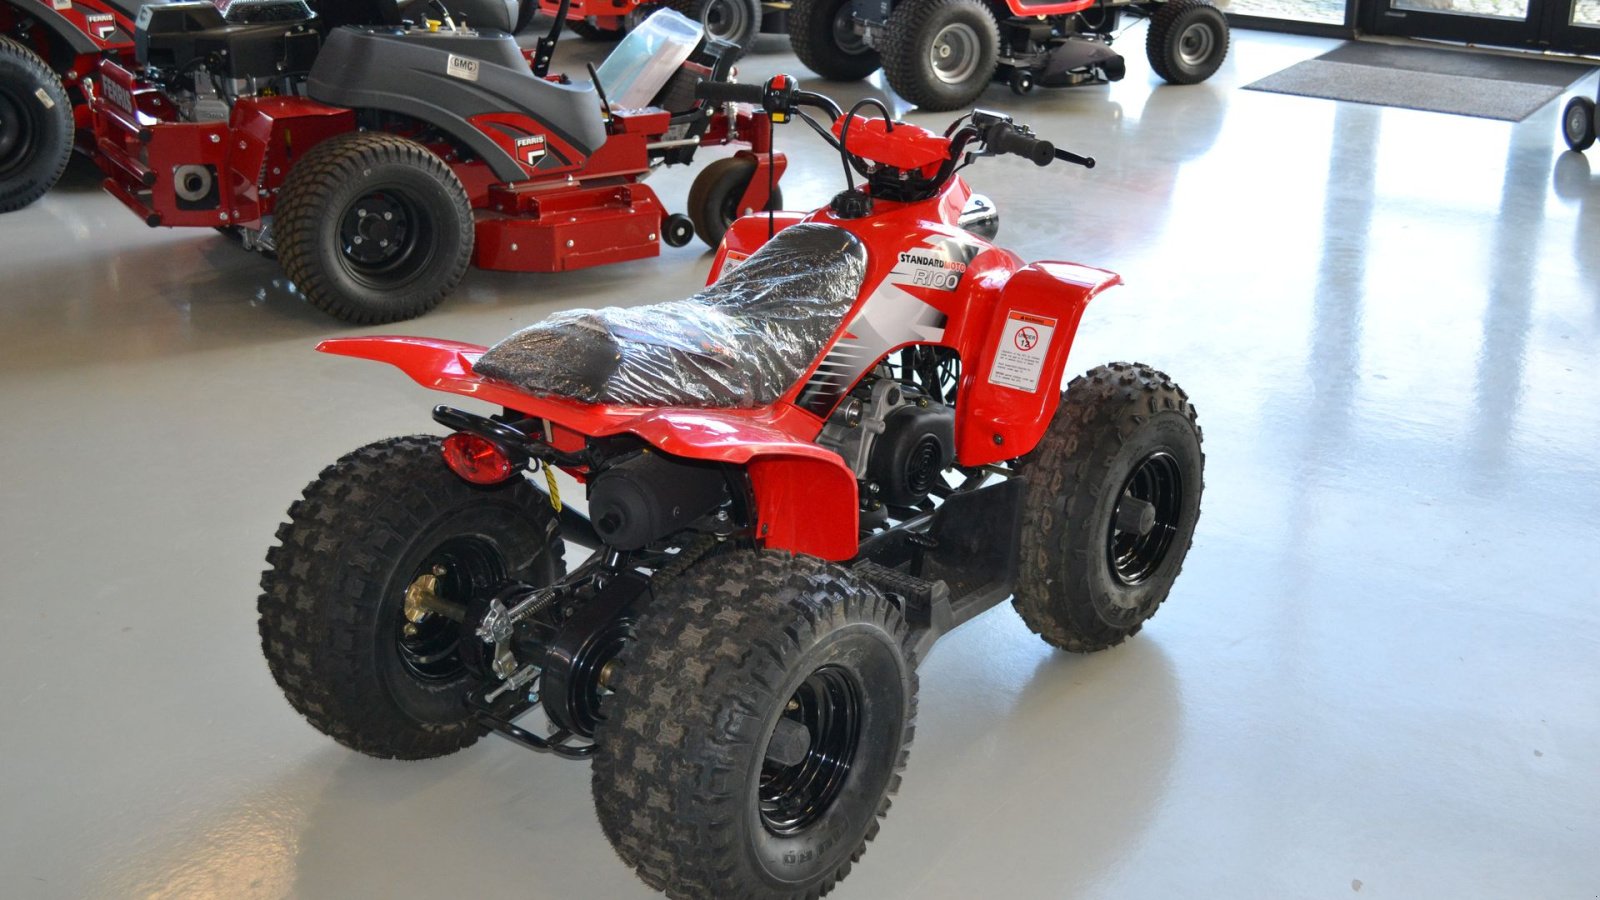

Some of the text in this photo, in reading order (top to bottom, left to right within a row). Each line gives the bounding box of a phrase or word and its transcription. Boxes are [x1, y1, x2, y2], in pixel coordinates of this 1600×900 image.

[88, 14, 113, 23] FERRIS
[454, 58, 473, 71] GMC
[102, 74, 133, 114] FERRIS
[518, 136, 544, 147] FERRIS
[913, 268, 959, 289] R100
